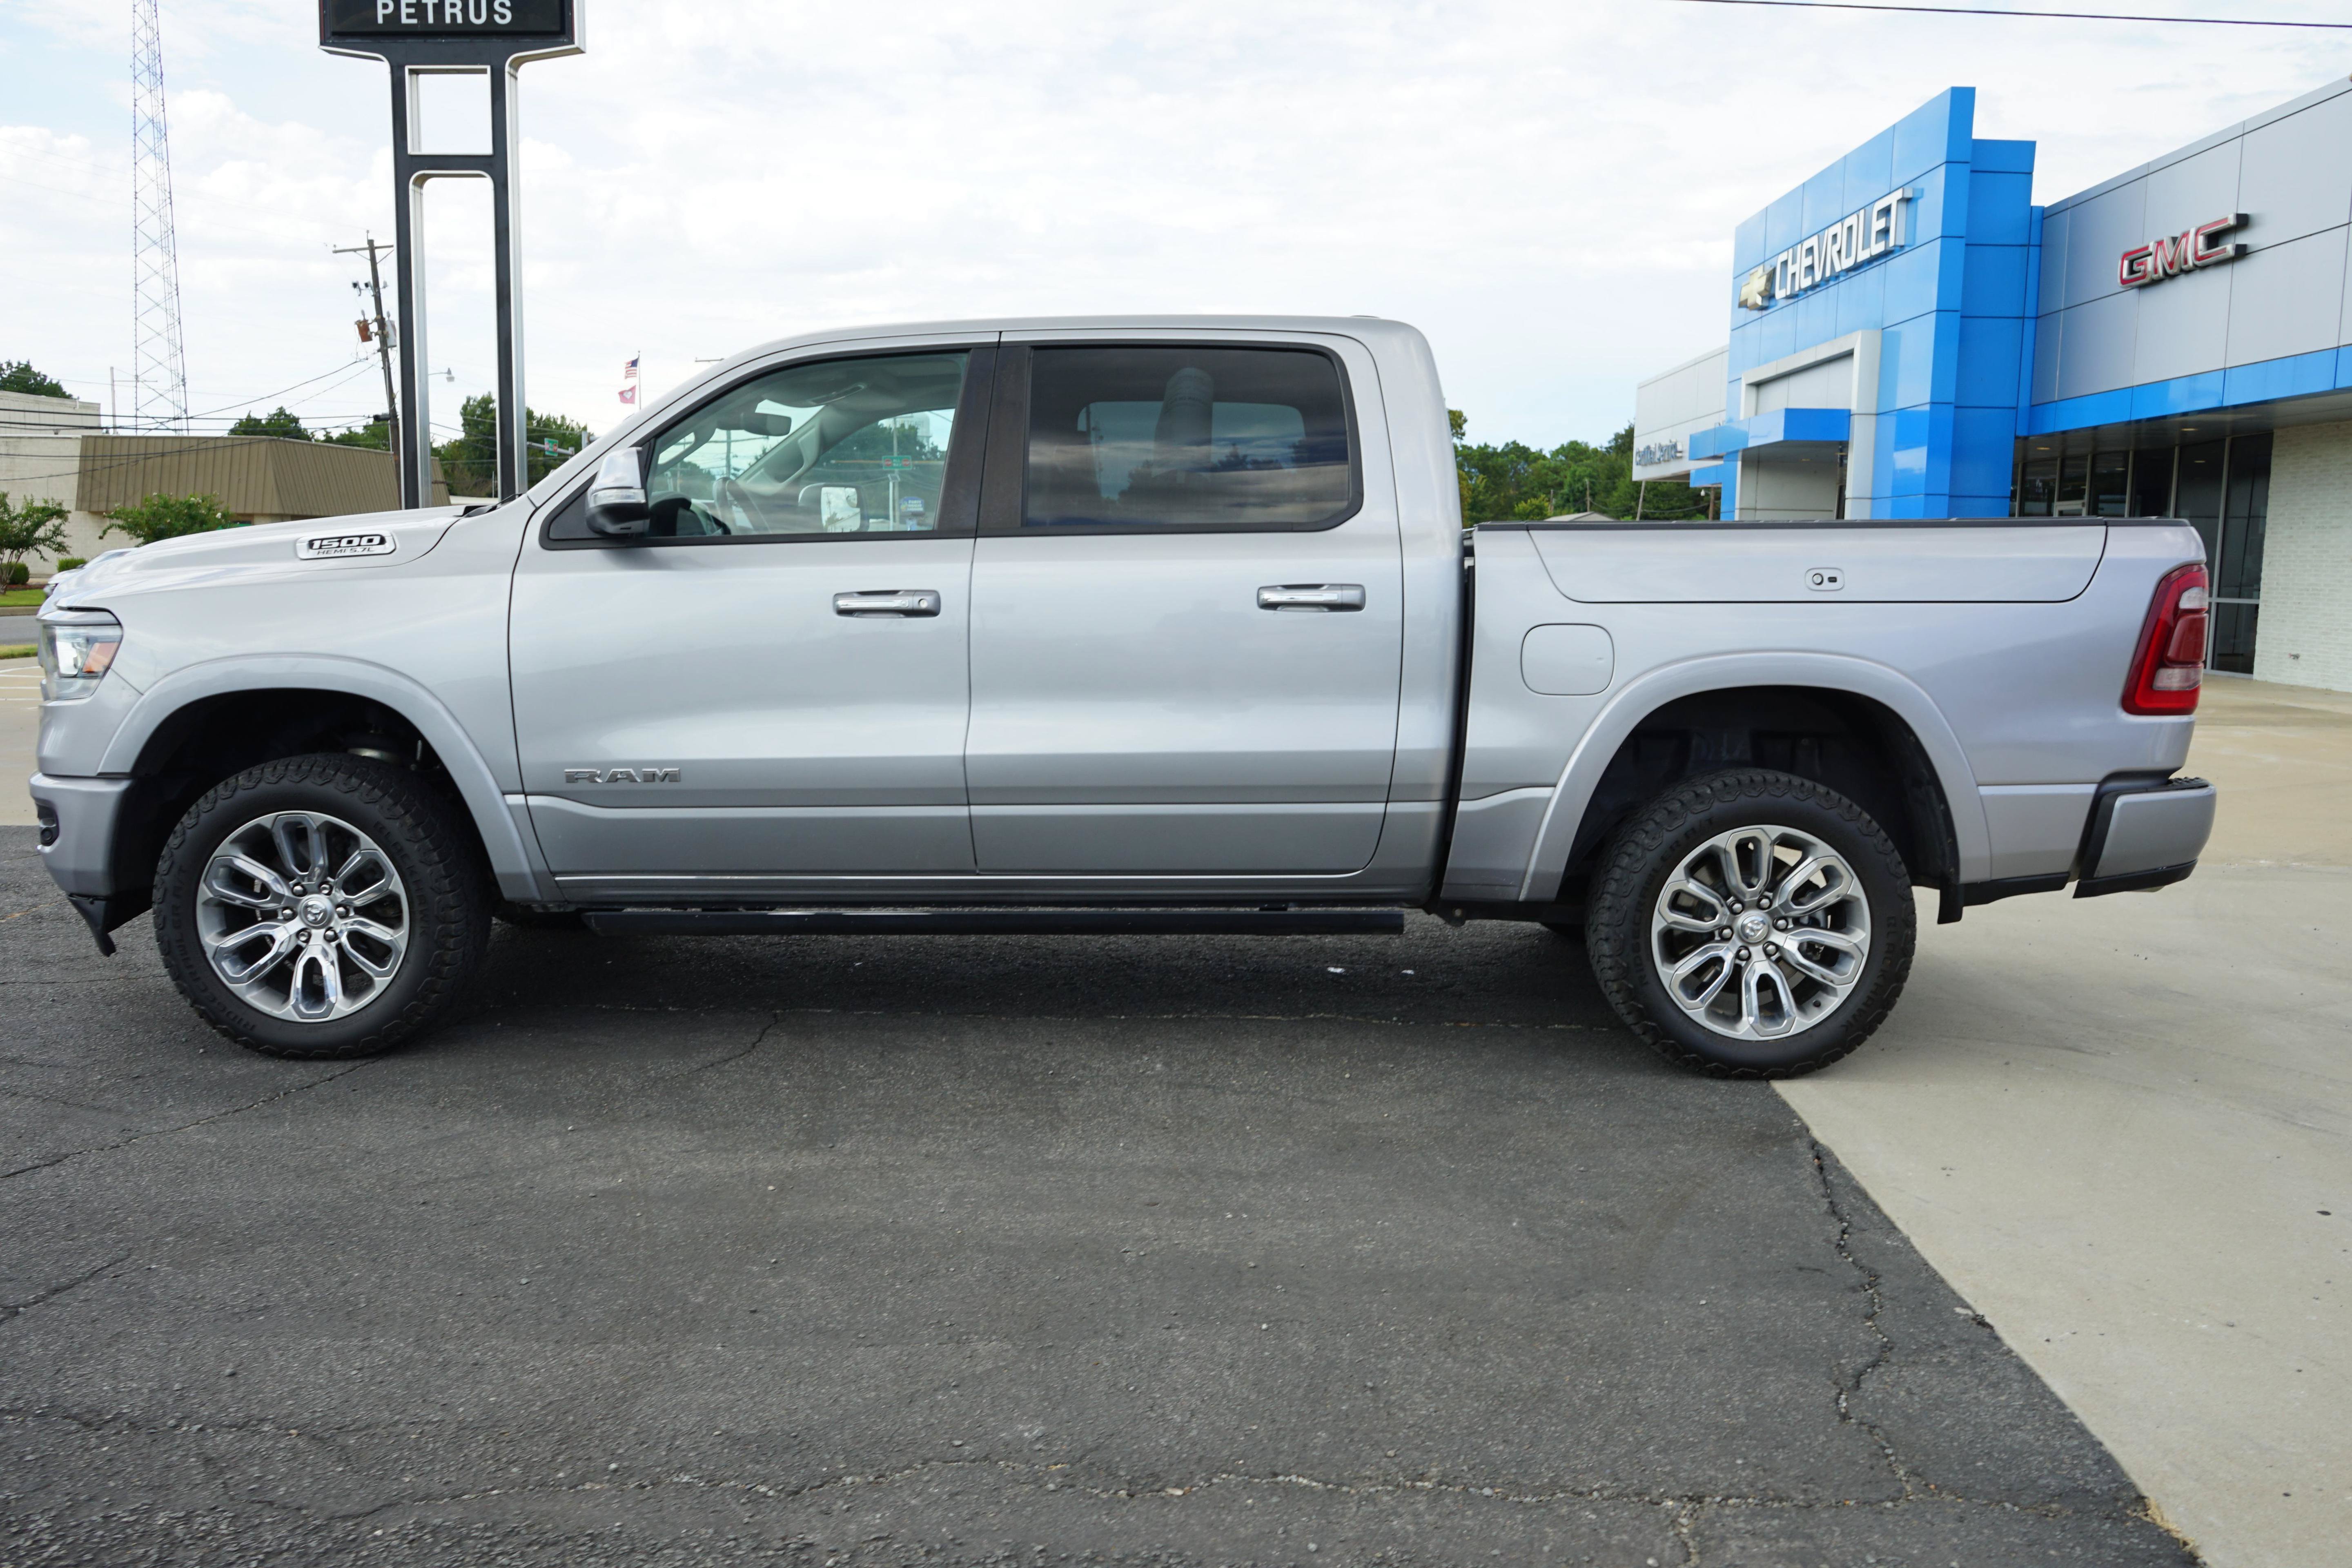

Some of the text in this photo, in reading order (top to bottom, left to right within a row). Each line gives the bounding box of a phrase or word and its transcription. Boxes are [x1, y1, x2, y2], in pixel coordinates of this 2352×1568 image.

[376, 0, 512, 24] PETRUS
[1775, 187, 1913, 300] CHEVROLET
[2118, 213, 2249, 288] GMC
[312, 535, 381, 549] 1500
[564, 768, 681, 783] RAM
